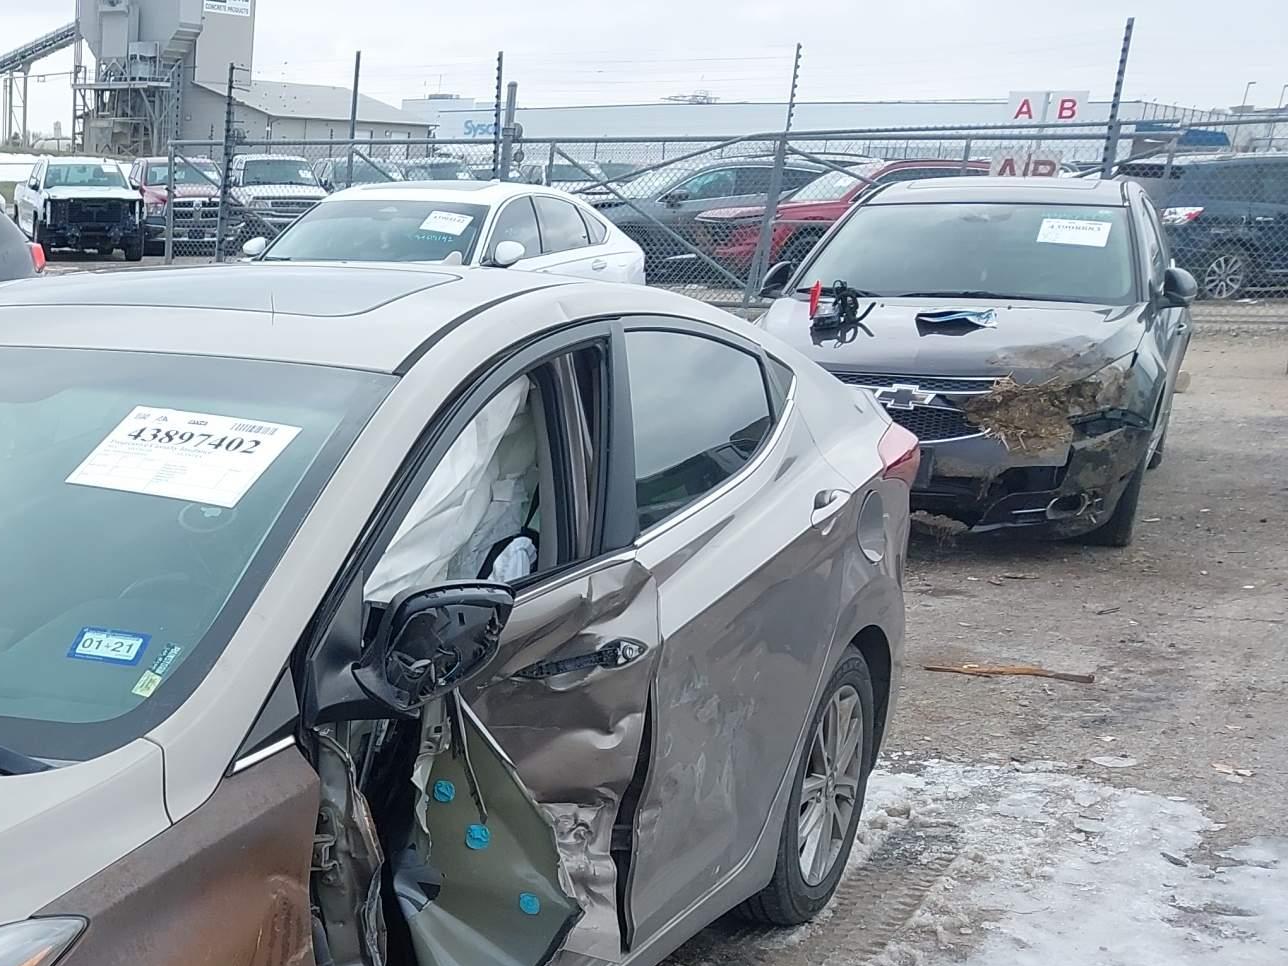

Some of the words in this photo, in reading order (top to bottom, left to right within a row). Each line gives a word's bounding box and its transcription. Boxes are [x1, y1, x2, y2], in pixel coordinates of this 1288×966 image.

[205, 3, 226, 12] CONCRETE
[227, 6, 249, 15] PRODUCTS
[1014, 99, 1033, 120] A
[1058, 99, 1077, 119] B
[463, 119, 497, 138] Sysc
[128, 426, 261, 454] 43897402
